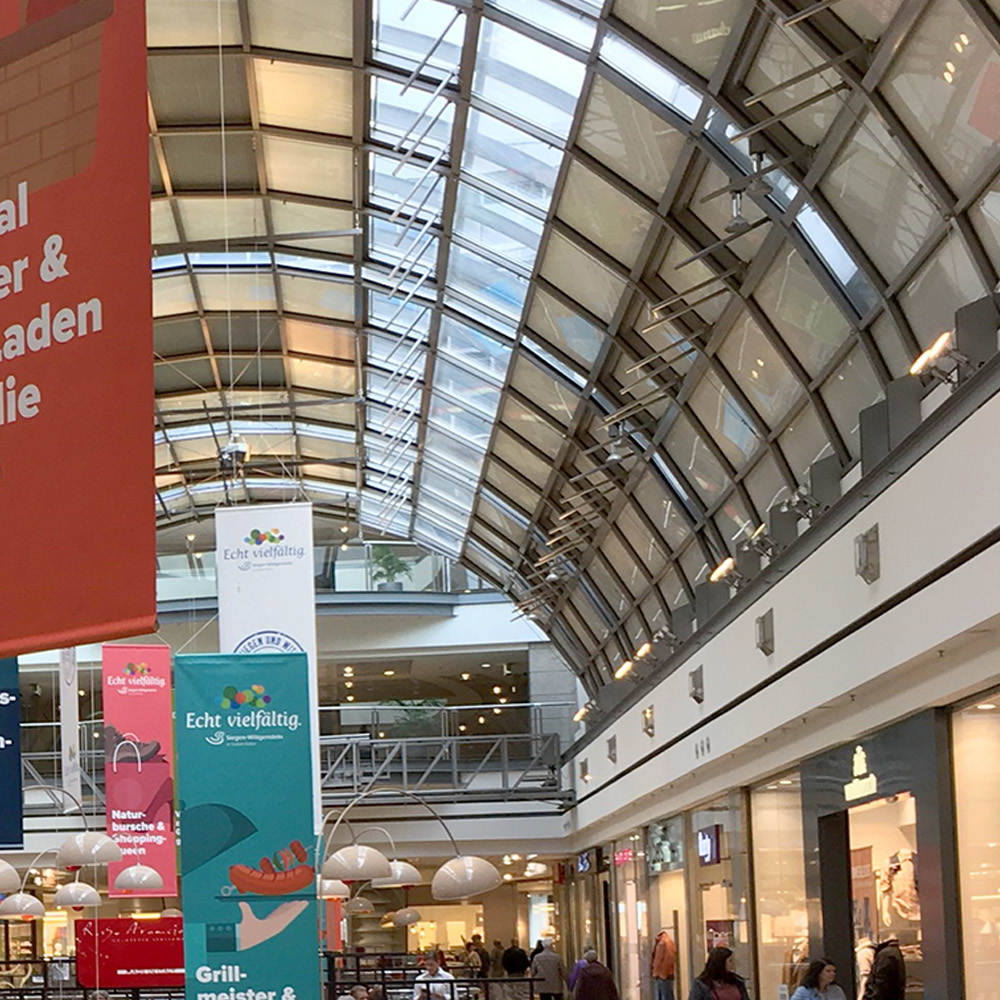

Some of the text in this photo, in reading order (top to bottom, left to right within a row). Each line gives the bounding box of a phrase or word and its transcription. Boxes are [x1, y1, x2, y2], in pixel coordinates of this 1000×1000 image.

[39, 234, 69, 282] &
[223, 548, 248, 560] Echt
[186, 710, 302, 731] Echt vielfältig.
[112, 810, 146, 819] Natur-
[112, 821, 166, 831] bursche &
[120, 847, 146, 855] ueen
[195, 965, 247, 983] Grill-
